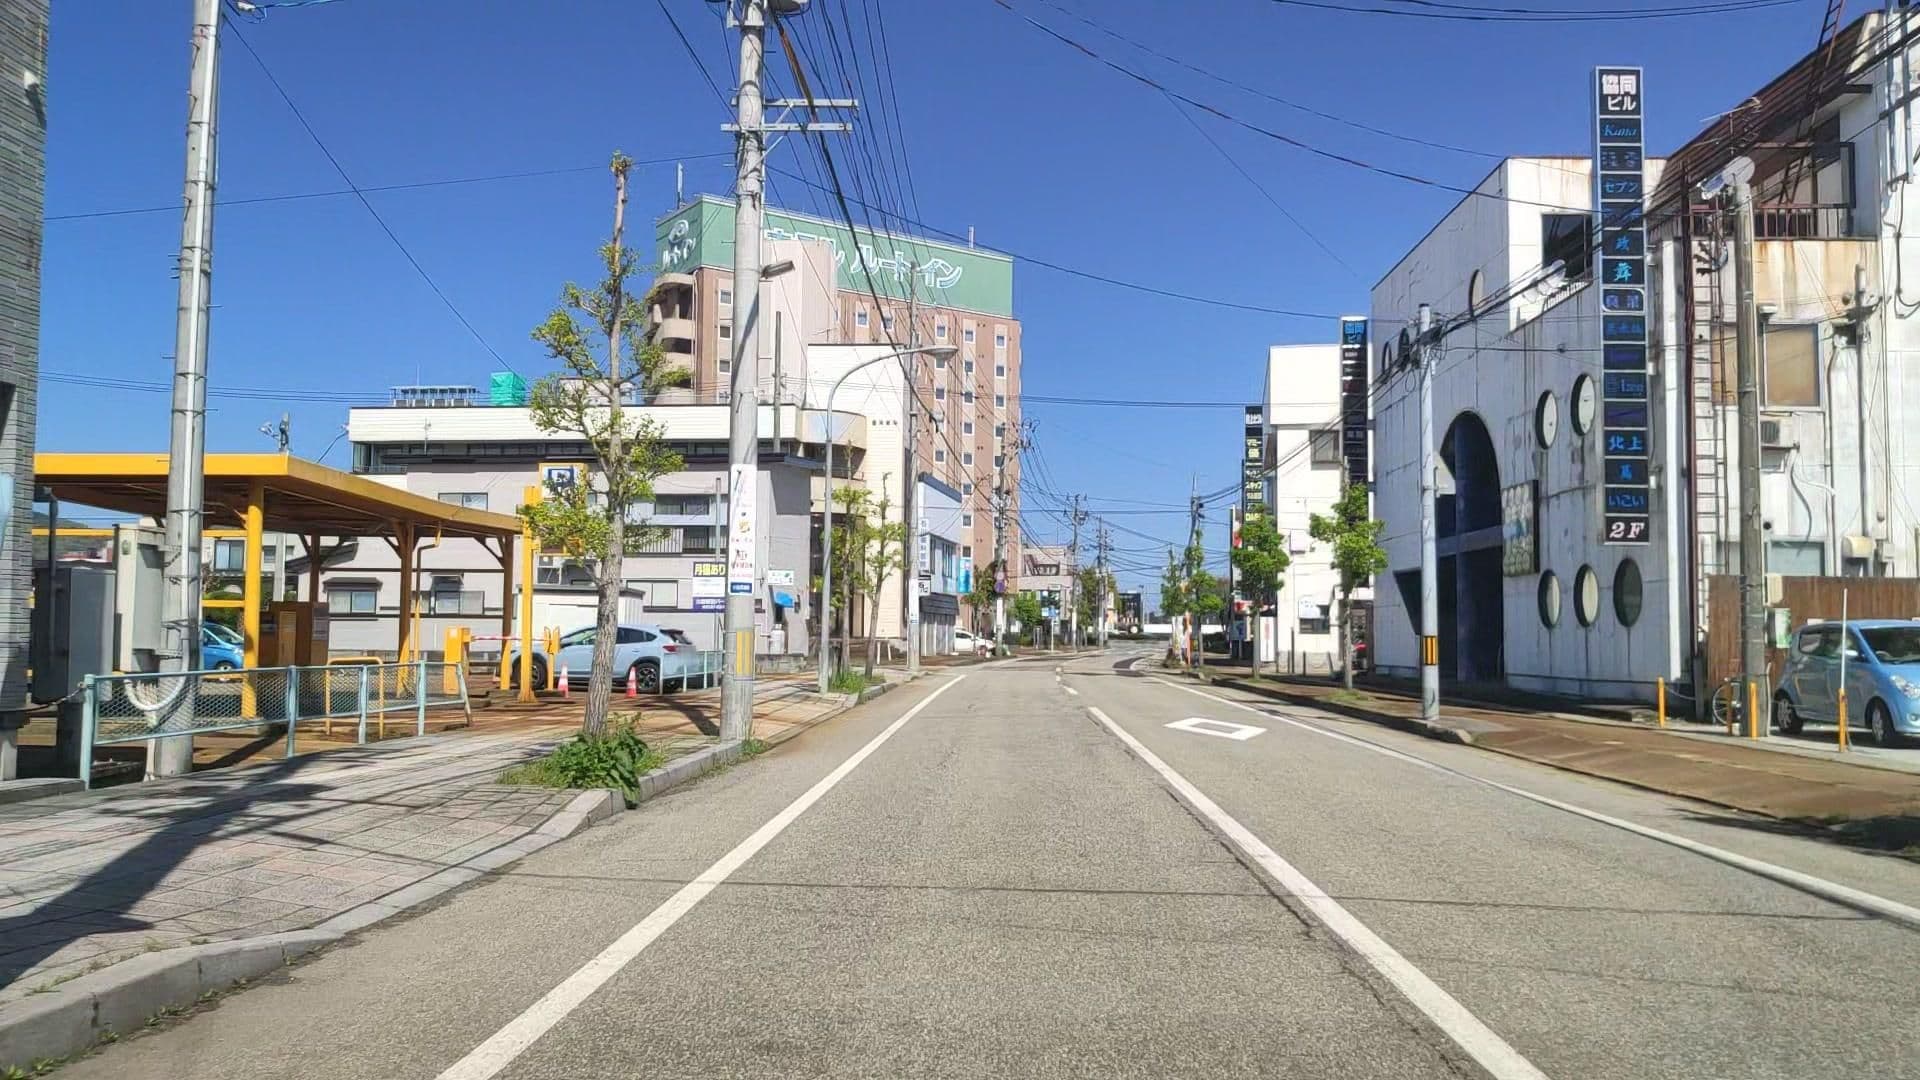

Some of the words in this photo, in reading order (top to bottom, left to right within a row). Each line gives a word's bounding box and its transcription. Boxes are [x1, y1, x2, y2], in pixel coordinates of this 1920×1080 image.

[1608, 96, 1636, 110] ビル
[850, 243, 962, 289] ルートイン
[1608, 435, 1644, 451] 北上
[1609, 493, 1645, 507] いこい
[1610, 521, 1645, 538] 2F
